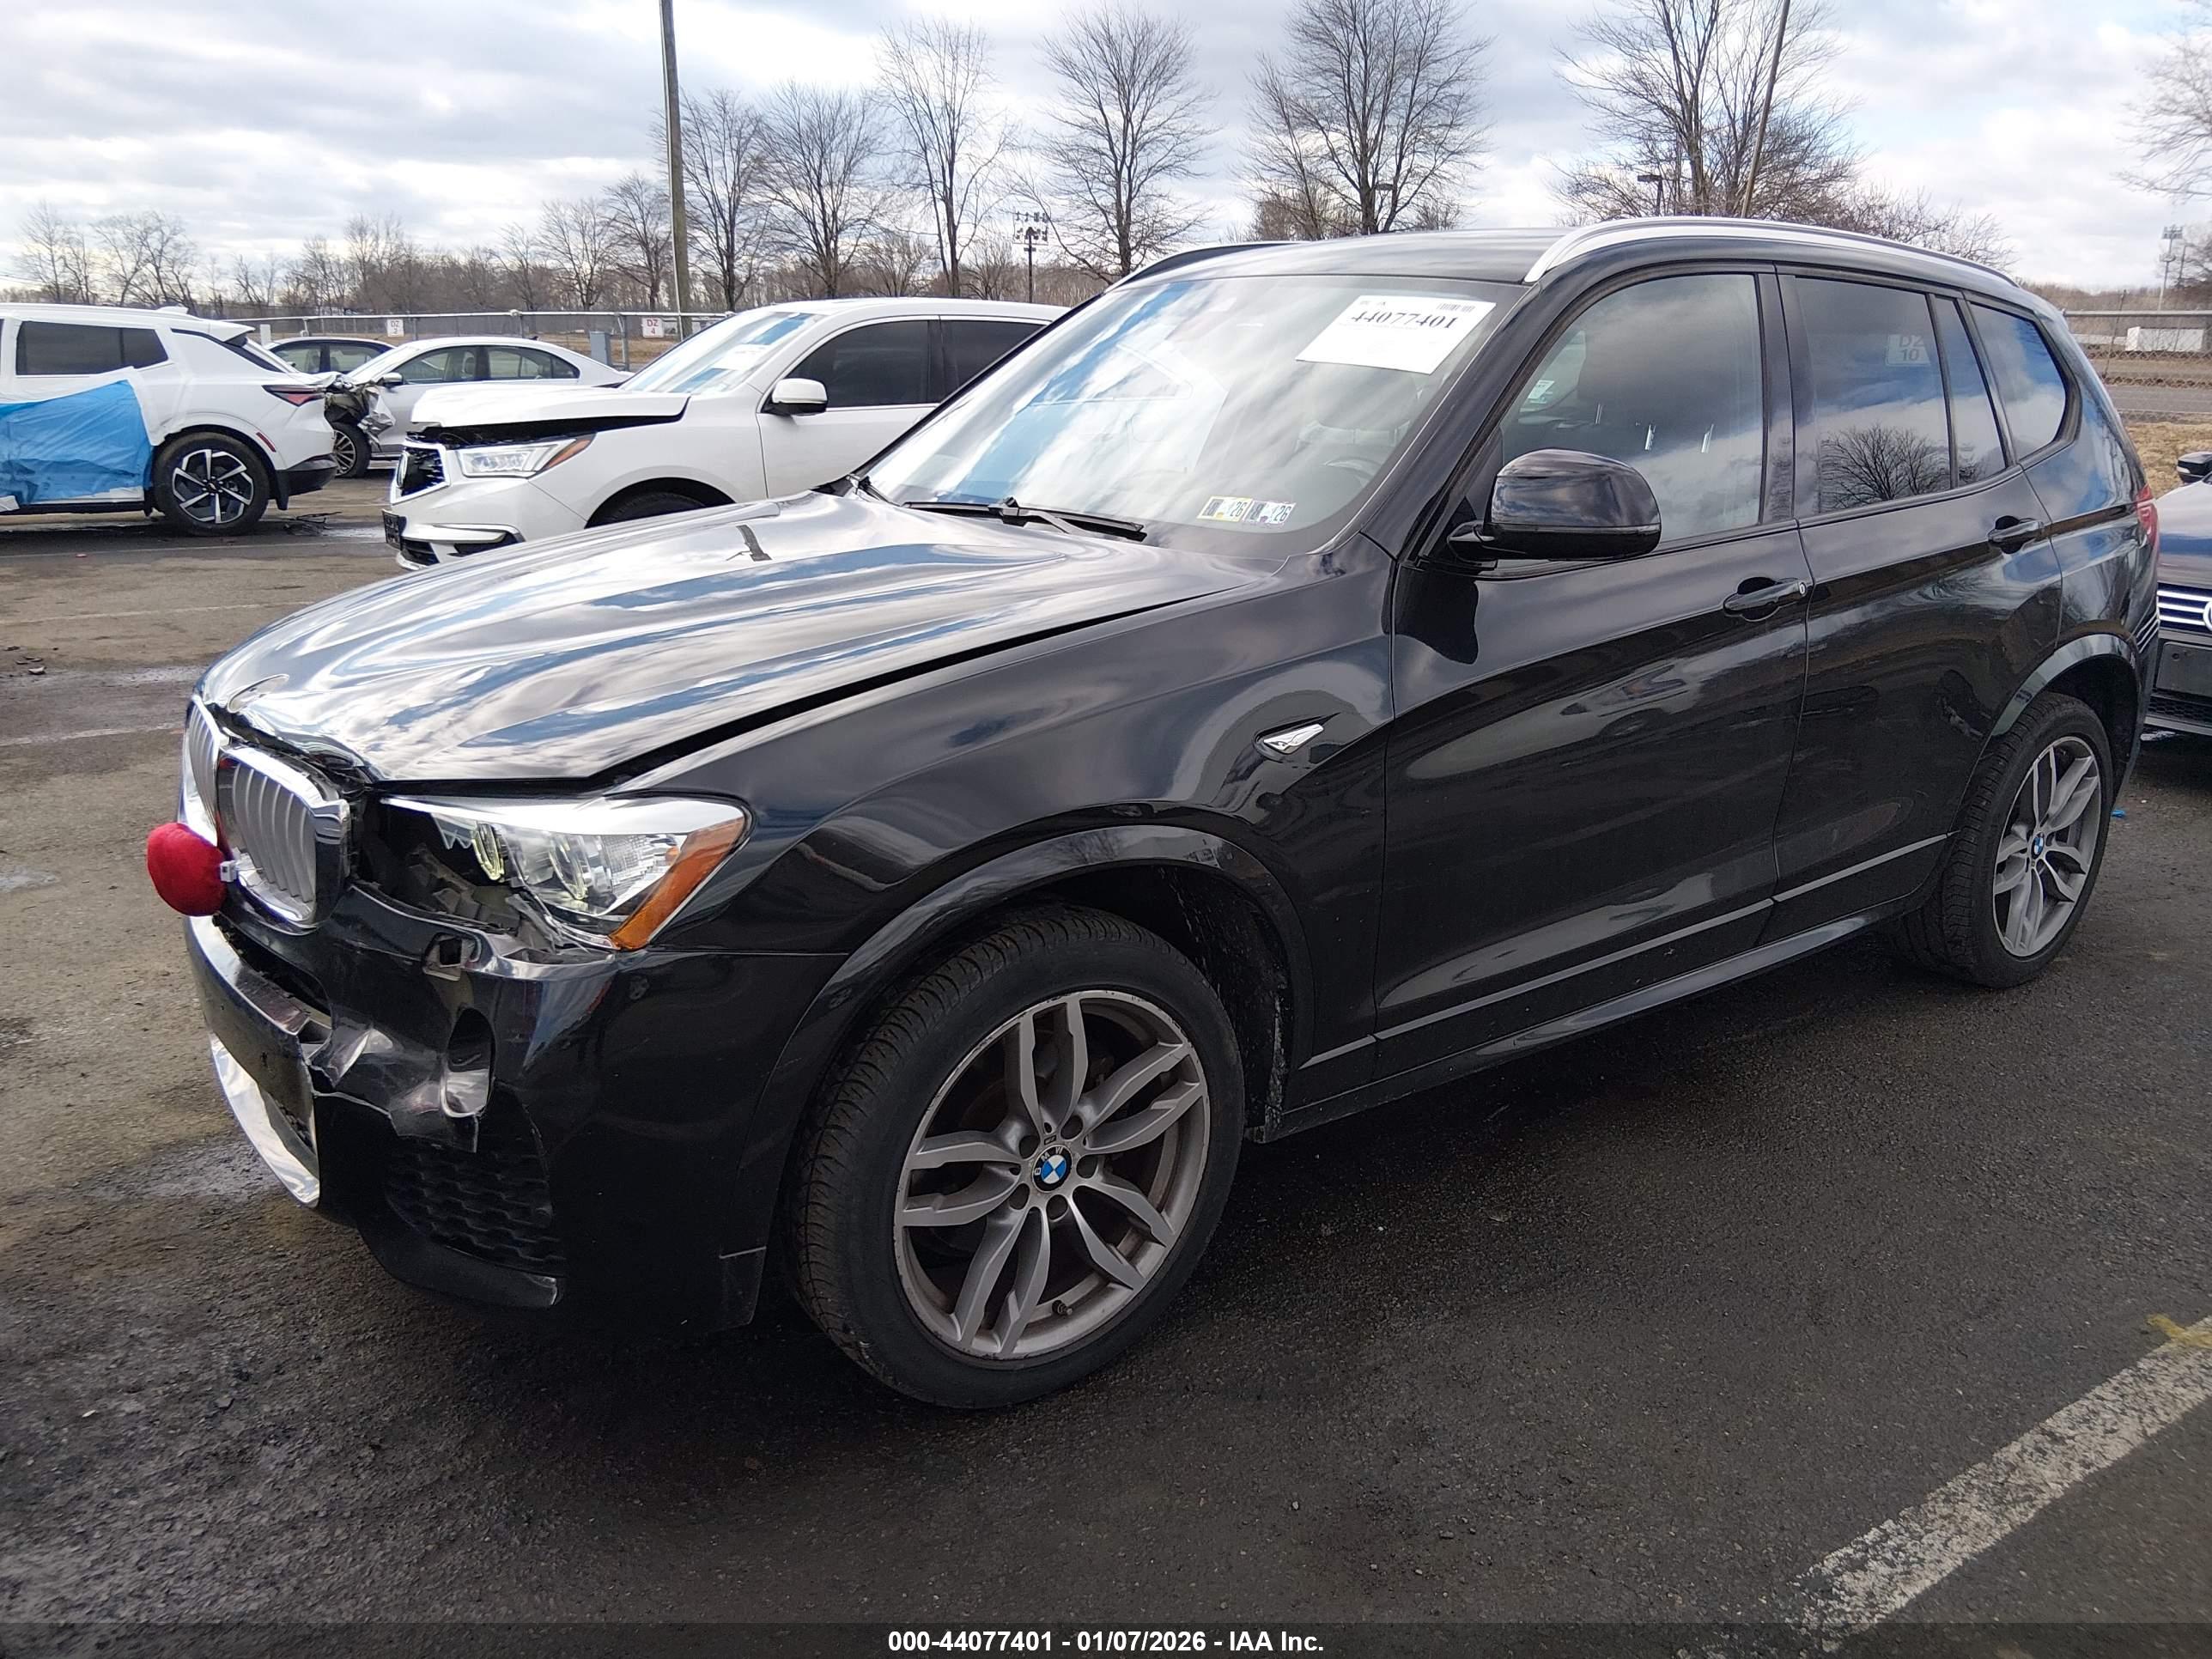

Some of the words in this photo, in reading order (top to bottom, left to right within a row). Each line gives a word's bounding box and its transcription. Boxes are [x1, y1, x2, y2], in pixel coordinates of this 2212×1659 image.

[1351, 311, 1459, 328] 44077401
[1901, 349, 1918, 361] 10
[1230, 501, 1247, 517] 26
[1274, 505, 1291, 521] 26
[1034, 1146, 1063, 1176] BMW
